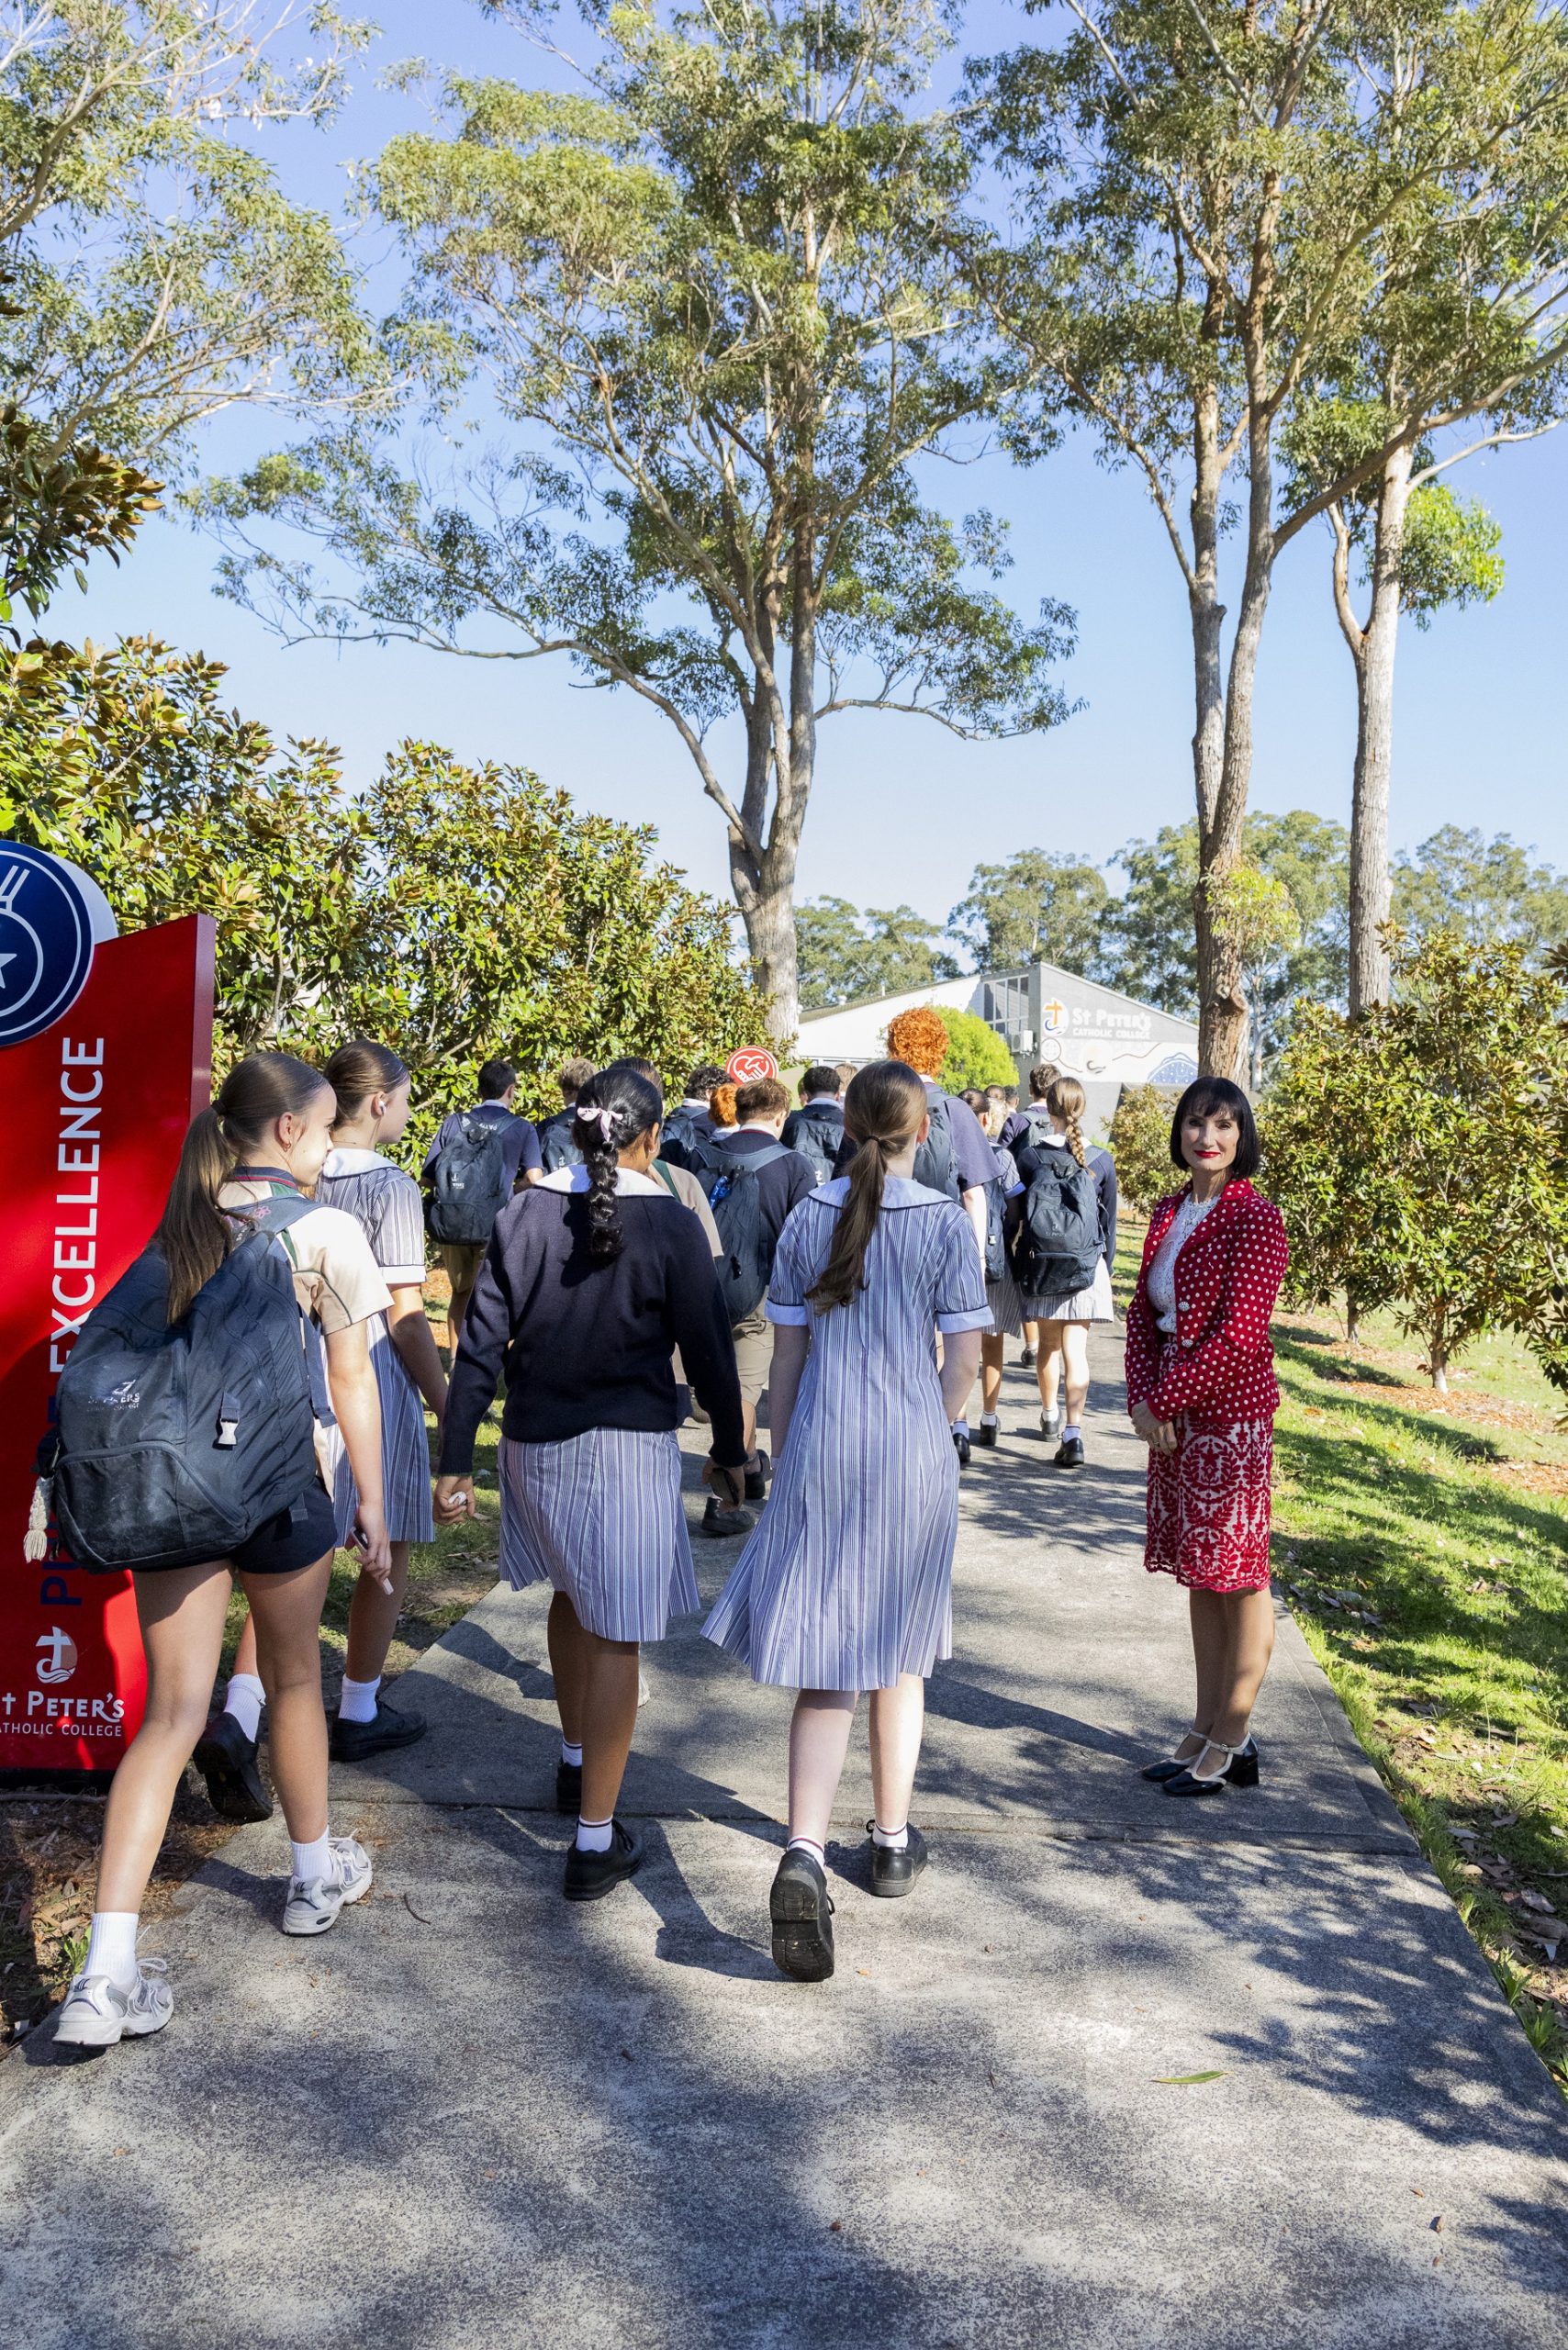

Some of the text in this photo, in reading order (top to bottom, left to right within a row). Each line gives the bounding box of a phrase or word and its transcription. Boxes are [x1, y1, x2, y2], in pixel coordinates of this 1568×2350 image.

[1072, 1007, 1151, 1030] St PETER'S
[1072, 1027, 1151, 1039] CATHOLIC COLLEGE
[27, 1691, 125, 1722] PETER'S
[62, 1724, 122, 1737] COLLEGE
